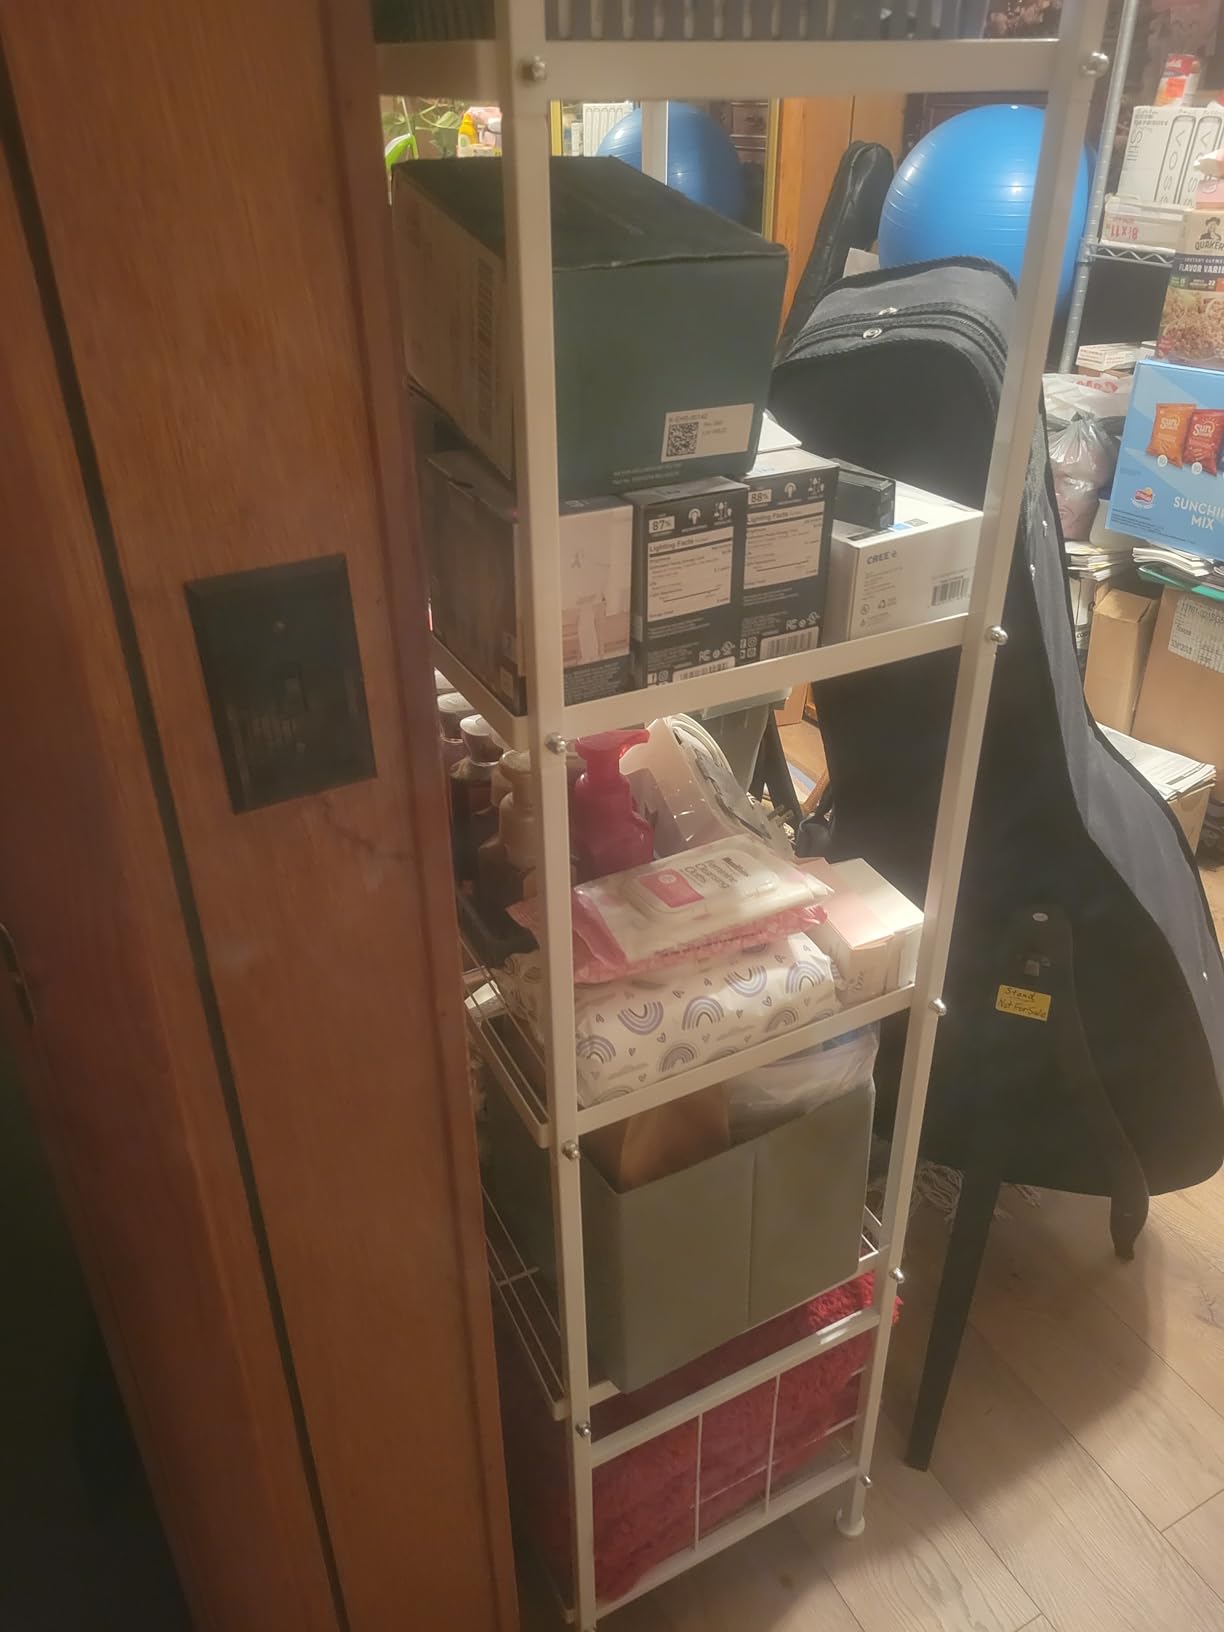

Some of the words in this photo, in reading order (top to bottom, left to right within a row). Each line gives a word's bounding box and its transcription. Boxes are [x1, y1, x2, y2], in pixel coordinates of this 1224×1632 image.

[1178, 264, 1202, 272] FLAVOR
[1193, 423, 1213, 437] Sun
[1190, 514, 1215, 531] MIX
[866, 551, 890, 565] CREE
